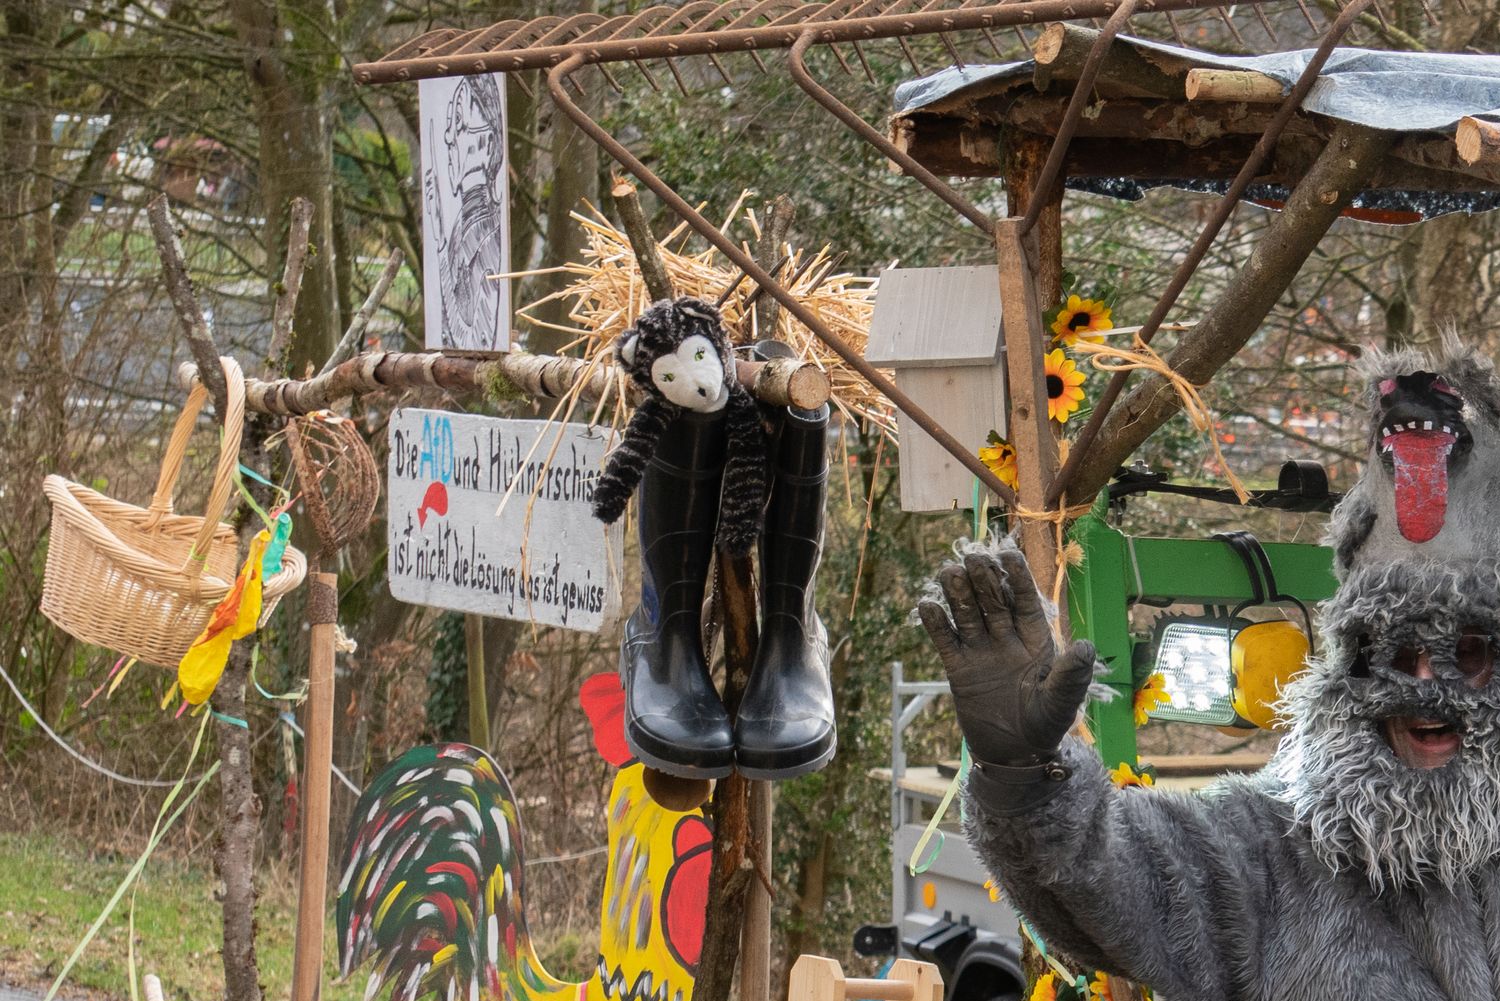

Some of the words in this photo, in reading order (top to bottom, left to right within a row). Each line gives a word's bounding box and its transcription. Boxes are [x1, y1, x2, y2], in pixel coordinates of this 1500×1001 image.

[394, 429, 418, 480] Die
[420, 414, 453, 483] AfD
[454, 435, 480, 491] und
[394, 511, 413, 576] ist
[416, 520, 451, 583] nicht
[453, 529, 468, 586] die
[543, 552, 560, 605] ist
[561, 569, 604, 626] gewiss
